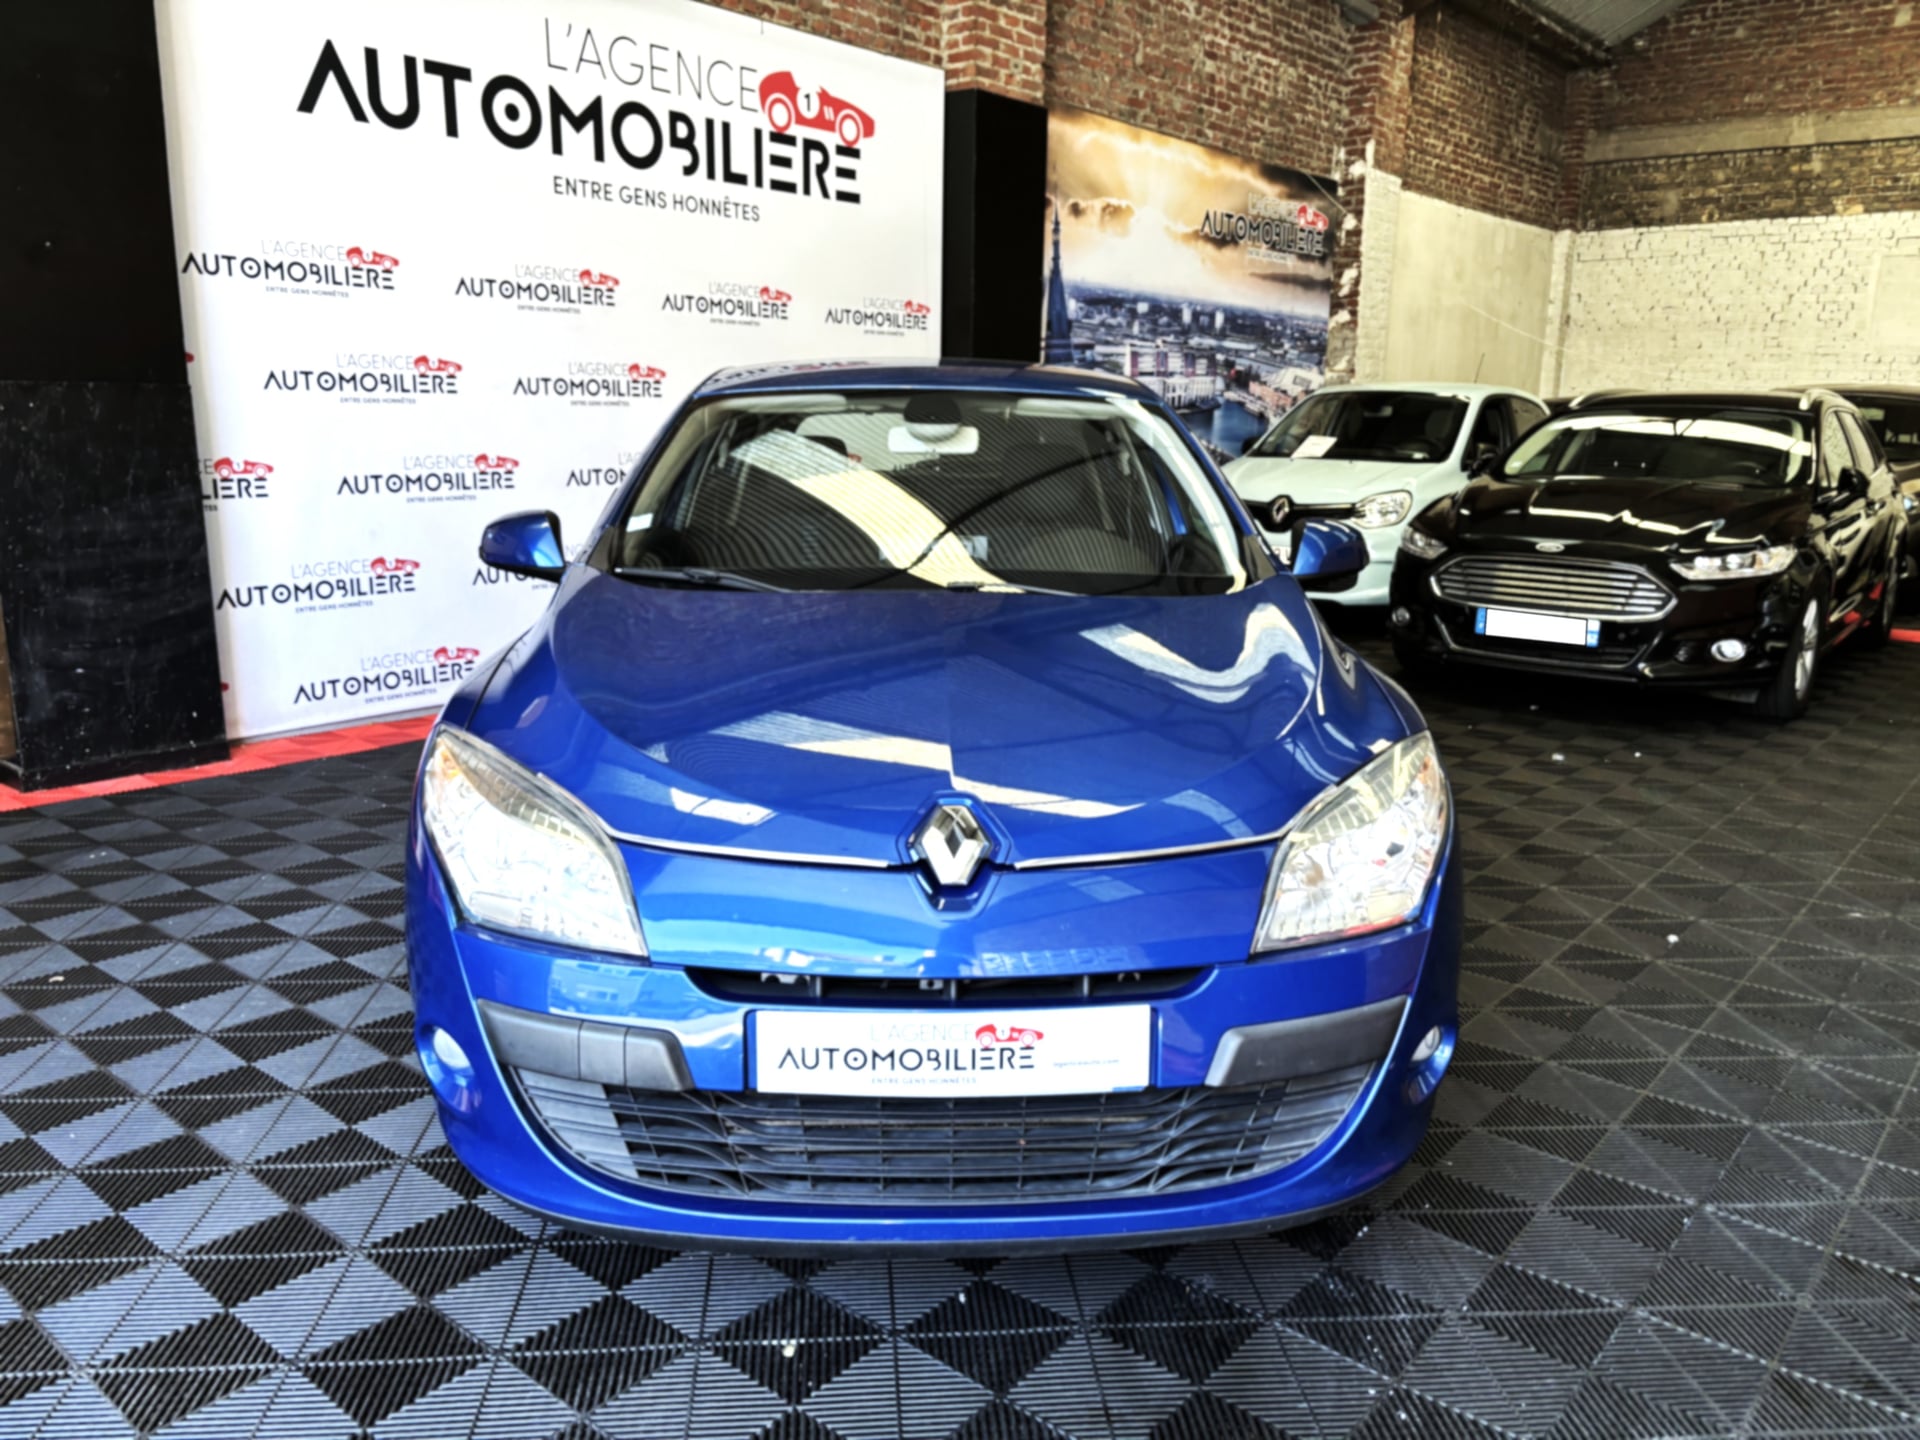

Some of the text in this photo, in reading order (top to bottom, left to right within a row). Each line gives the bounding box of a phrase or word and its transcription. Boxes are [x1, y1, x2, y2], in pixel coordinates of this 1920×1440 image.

[545, 17, 758, 113] L'AGENCE
[297, 38, 861, 204] AUTOMOBILIERE
[553, 175, 760, 222] ENTRE GENS HONNÊTES
[261, 239, 346, 262] L'AGENCE
[181, 252, 395, 291] AUTOMOBILIERE
[455, 277, 615, 307] AUTOMOBILIERE
[661, 294, 788, 320] AUTOMOBILIERE
[336, 353, 413, 370] L'AGENCE
[263, 370, 458, 394] AUTOMOBILIERE
[513, 377, 662, 398] AUTOMOBILIERE
[403, 454, 474, 470] L'AGENCE
[337, 470, 515, 495] AUTOMOBILIERE
[291, 558, 370, 579] L'AGENCE
[216, 573, 416, 610] AUTOMOBILIERE
[360, 649, 434, 673] L'AGENCE
[870, 1023, 974, 1042] L'AGENCE
[778, 1046, 1035, 1072] AUTOMOBILIERE
